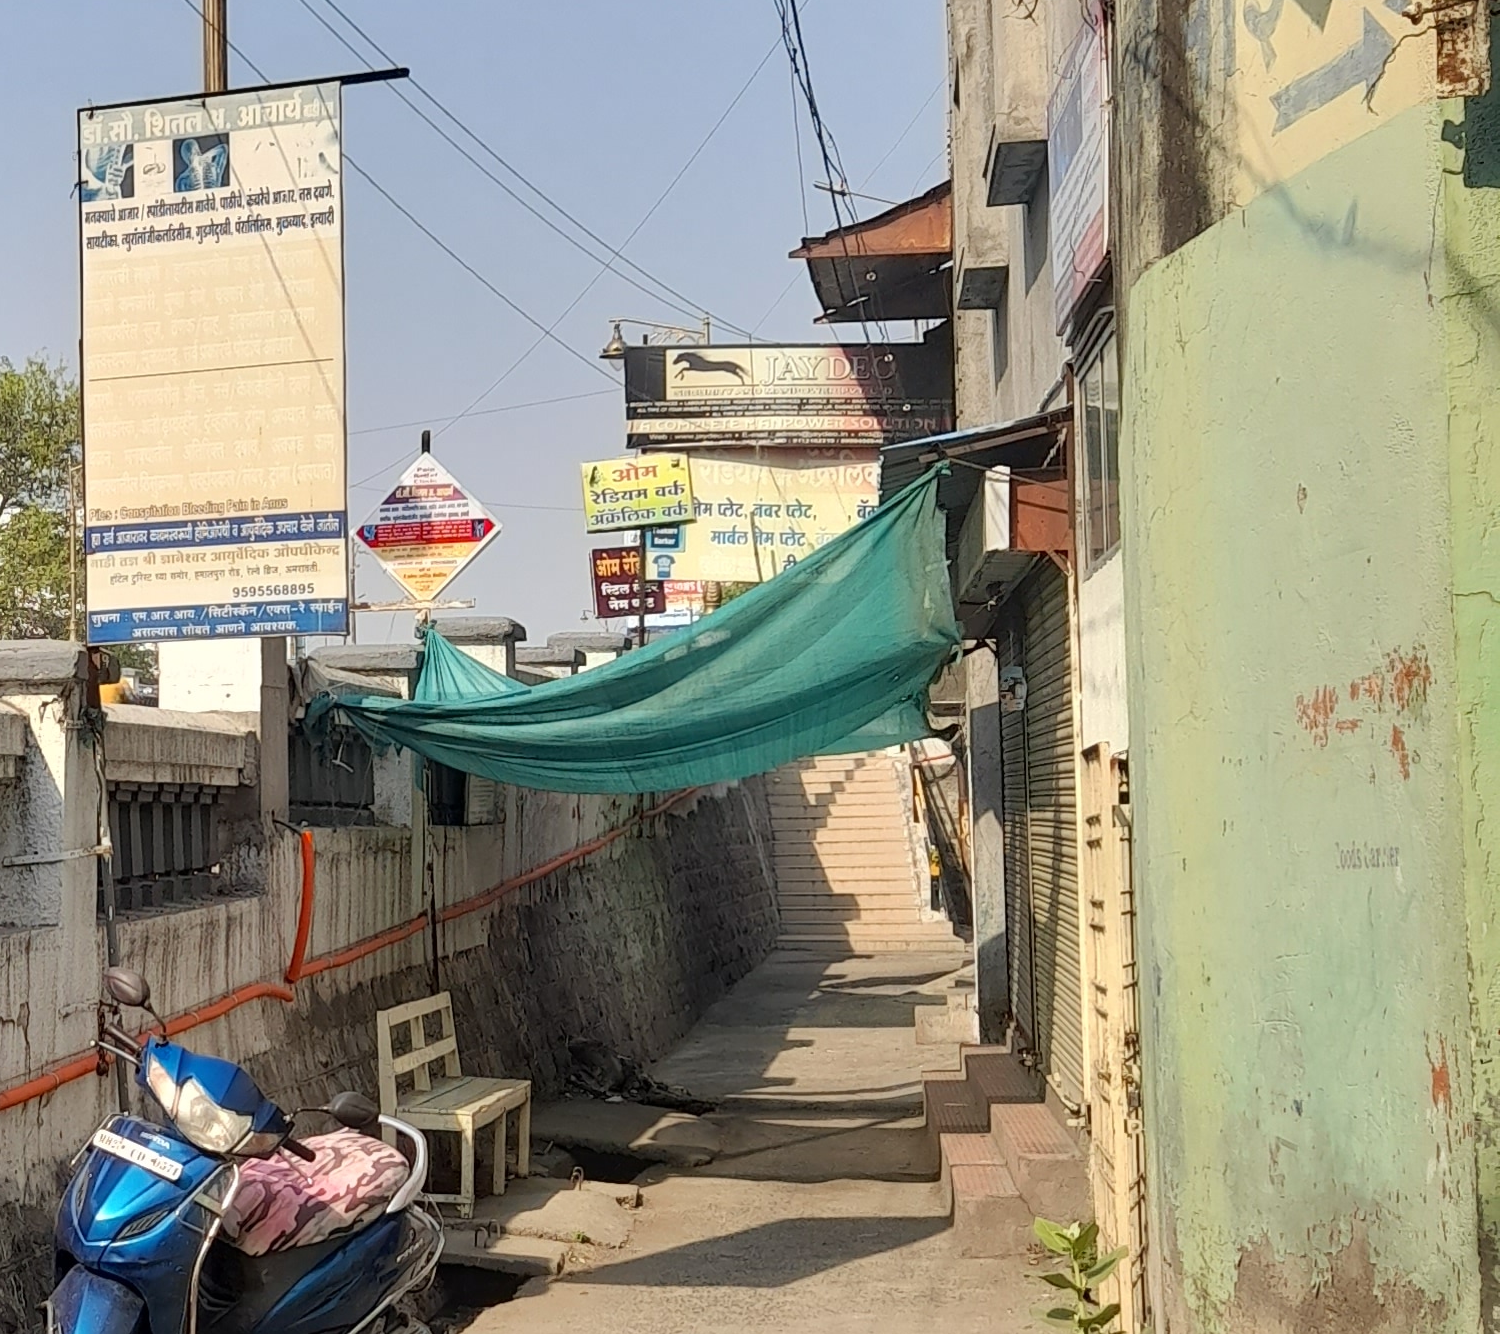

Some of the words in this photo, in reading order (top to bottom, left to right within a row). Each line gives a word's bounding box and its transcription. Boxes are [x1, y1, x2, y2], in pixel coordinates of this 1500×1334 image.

[144, 108, 202, 139] शितल
[237, 90, 302, 126] आचार्य
[655, 419, 741, 432] COMPLETE
[745, 417, 846, 429] MANPOWER
[612, 462, 658, 483] ओम
[590, 488, 648, 504] रेडियम
[655, 480, 686, 497] वर्क
[182, 500, 225, 516] Bleeding
[226, 498, 249, 513] Pain
[250, 498, 260, 510] in
[261, 497, 288, 509] Anus
[662, 500, 688, 517] वर्क
[143, 551, 156, 565] श्री
[210, 546, 269, 565] आयुर्वेदिक
[596, 553, 620, 576] ओम
[232, 583, 315, 598] 9595568895
[132, 626, 178, 638] असल्यास
[182, 622, 210, 636] सोबत
[251, 620, 299, 633] आवश्यक.
